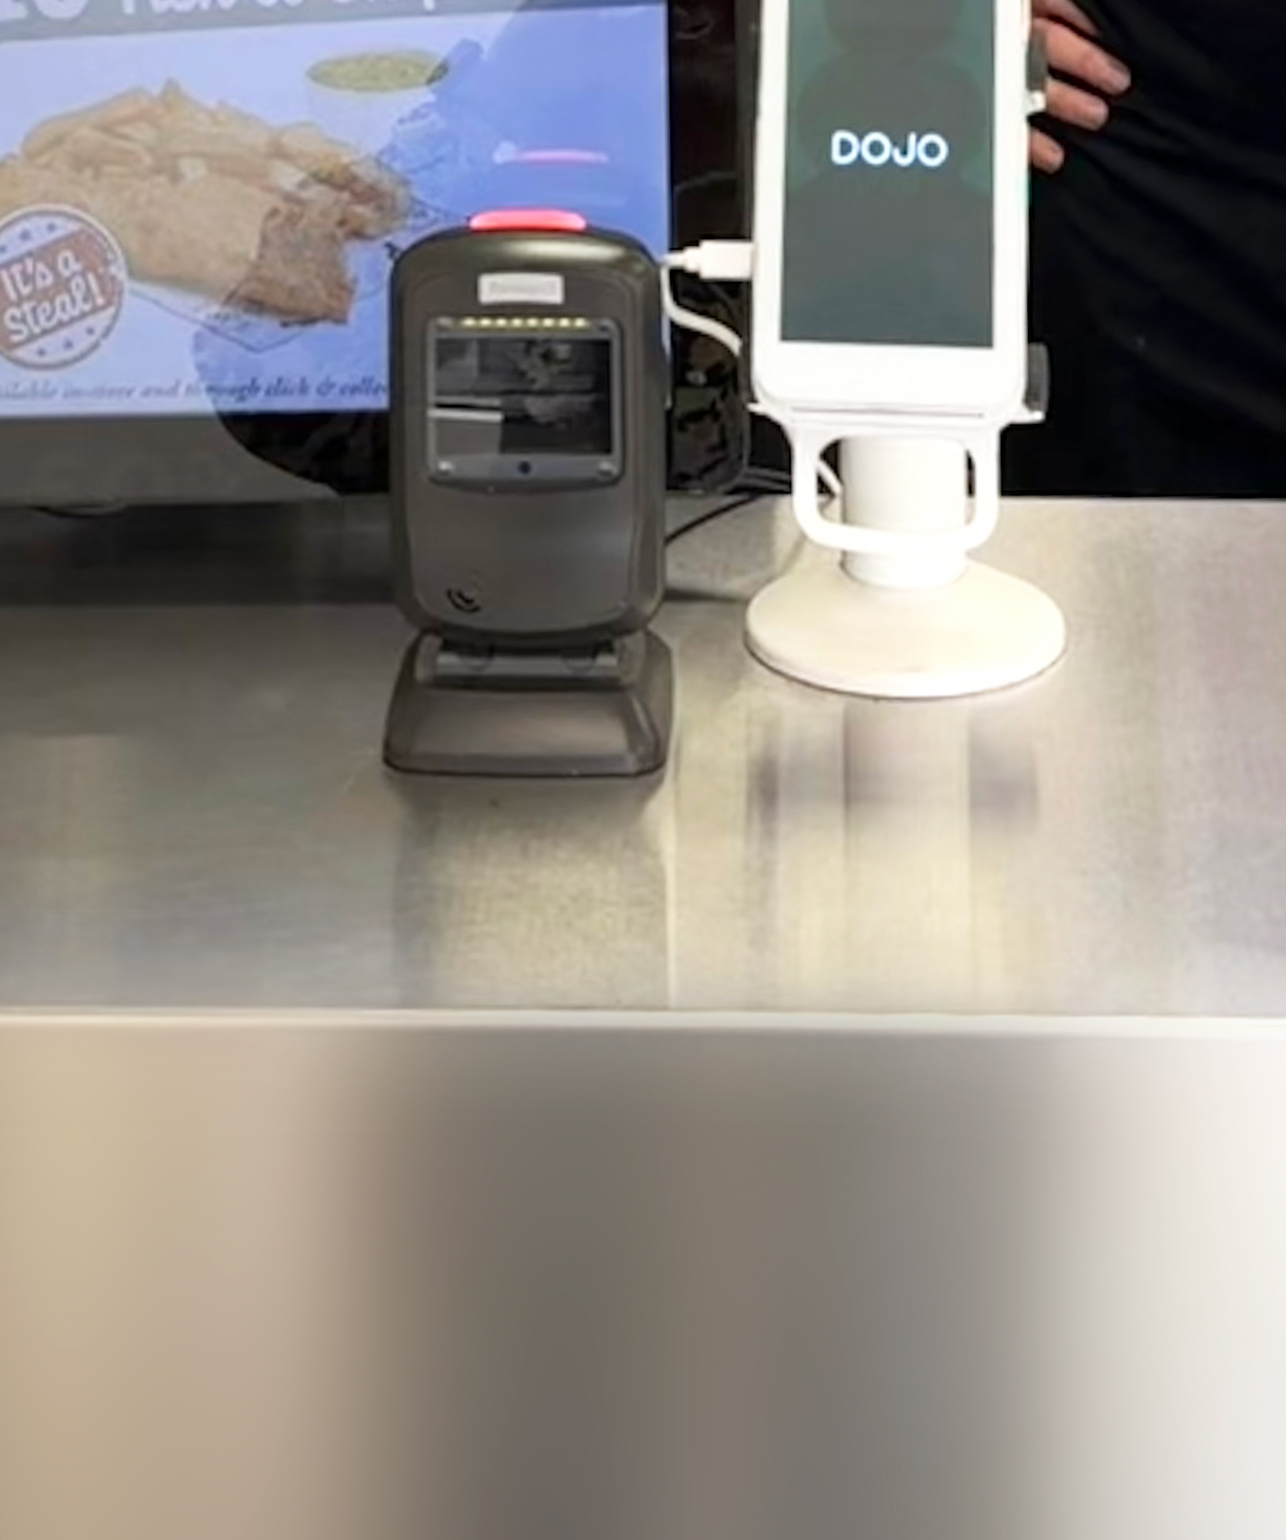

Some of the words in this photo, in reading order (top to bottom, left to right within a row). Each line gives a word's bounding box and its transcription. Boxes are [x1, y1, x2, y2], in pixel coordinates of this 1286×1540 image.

[831, 129, 948, 167] DOJO
[57, 249, 82, 277] a
[2, 276, 106, 343] Steal!
